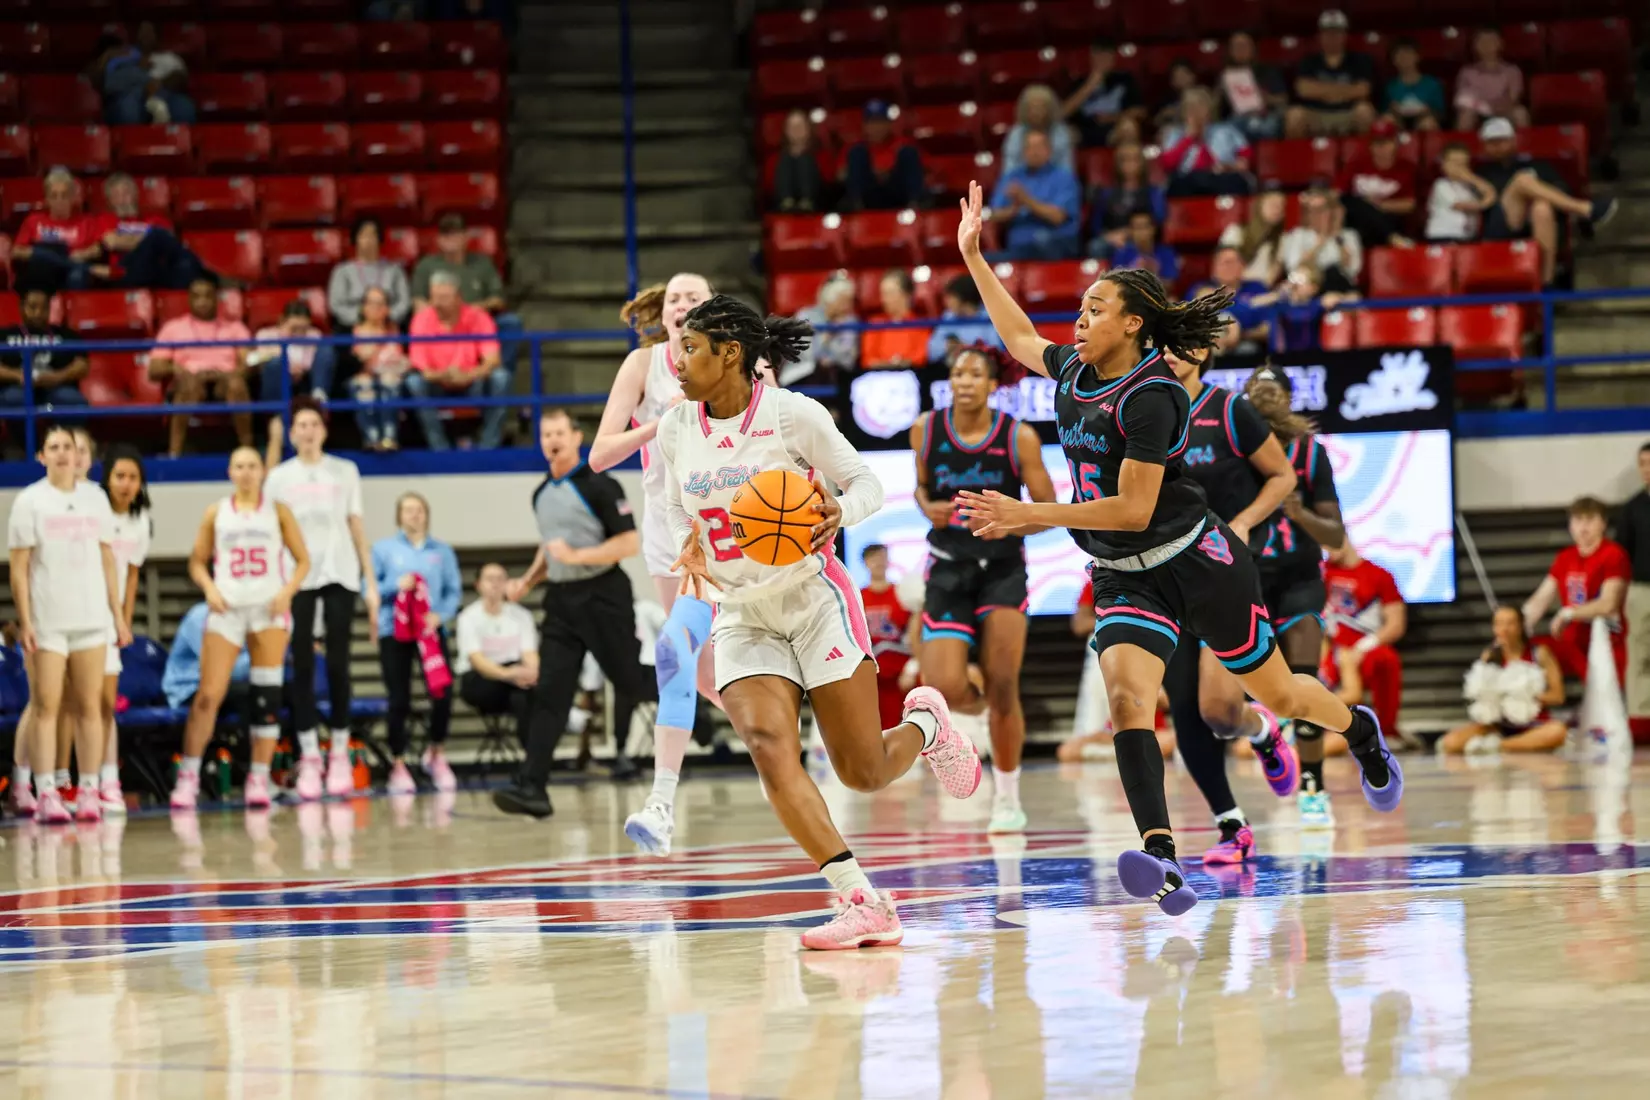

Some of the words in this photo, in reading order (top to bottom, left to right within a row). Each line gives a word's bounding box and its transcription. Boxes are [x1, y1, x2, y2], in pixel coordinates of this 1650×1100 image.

[751, 429, 774, 437] C-USA
[684, 470, 712, 499] Lady
[713, 464, 760, 489] Tech
[1067, 458, 1106, 503] 15
[229, 545, 269, 578] 25
